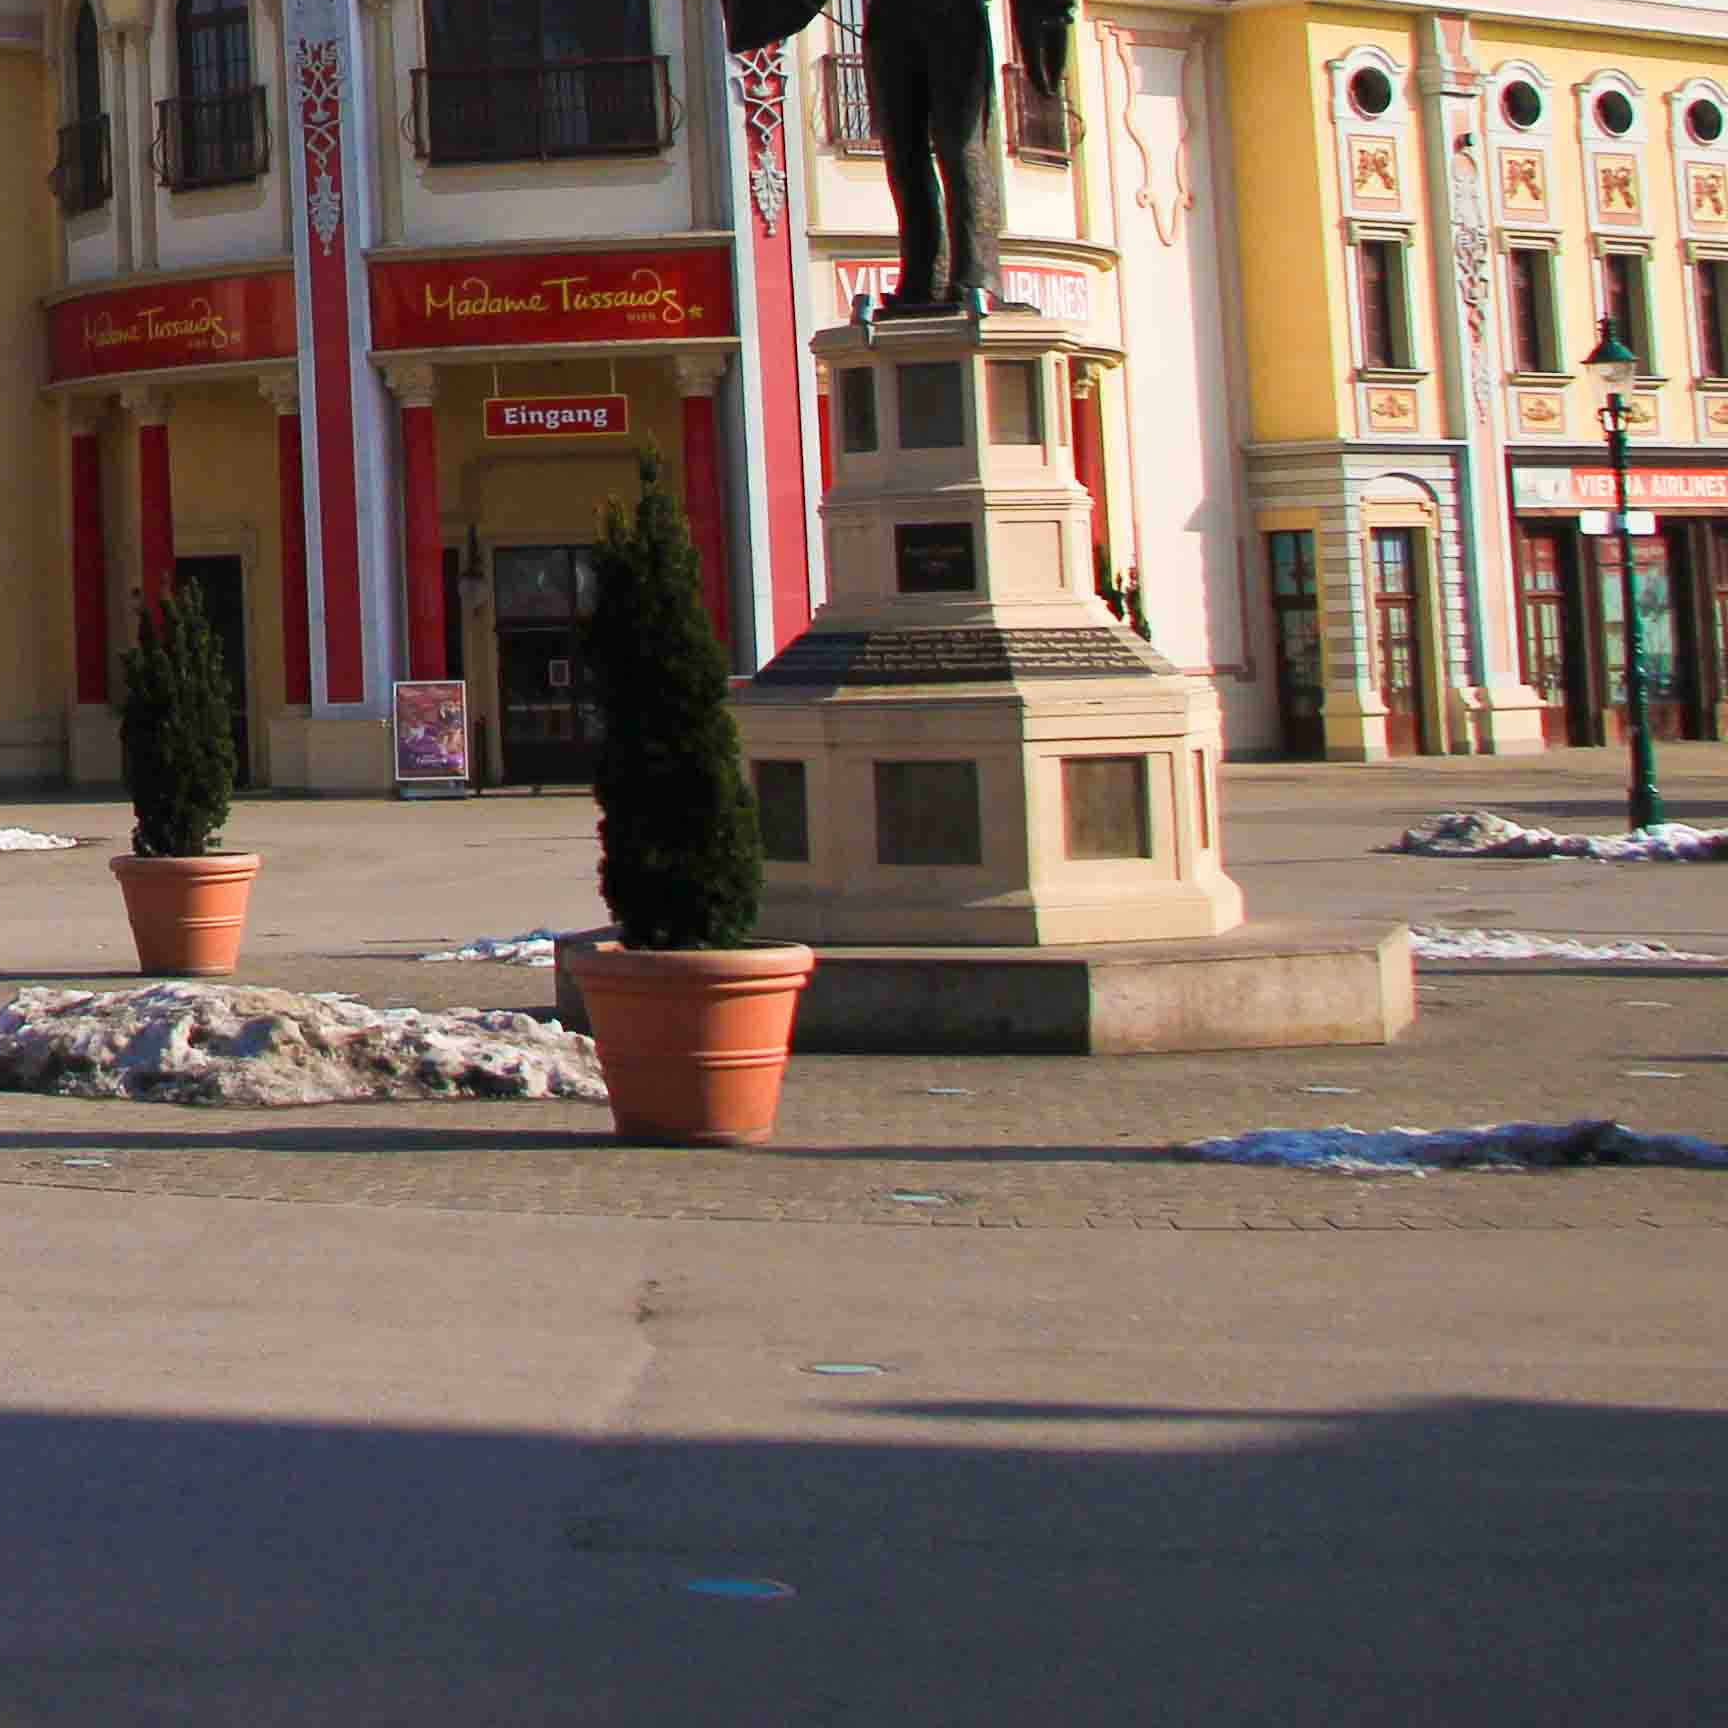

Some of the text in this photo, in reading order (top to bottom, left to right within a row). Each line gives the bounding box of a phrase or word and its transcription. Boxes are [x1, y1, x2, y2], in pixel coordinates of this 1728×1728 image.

[424, 268, 684, 324] Madame Tussauds
[135, 297, 227, 349] Tussauds
[503, 405, 609, 430] Eingang
[1650, 474, 1727, 497] AIRLINES
